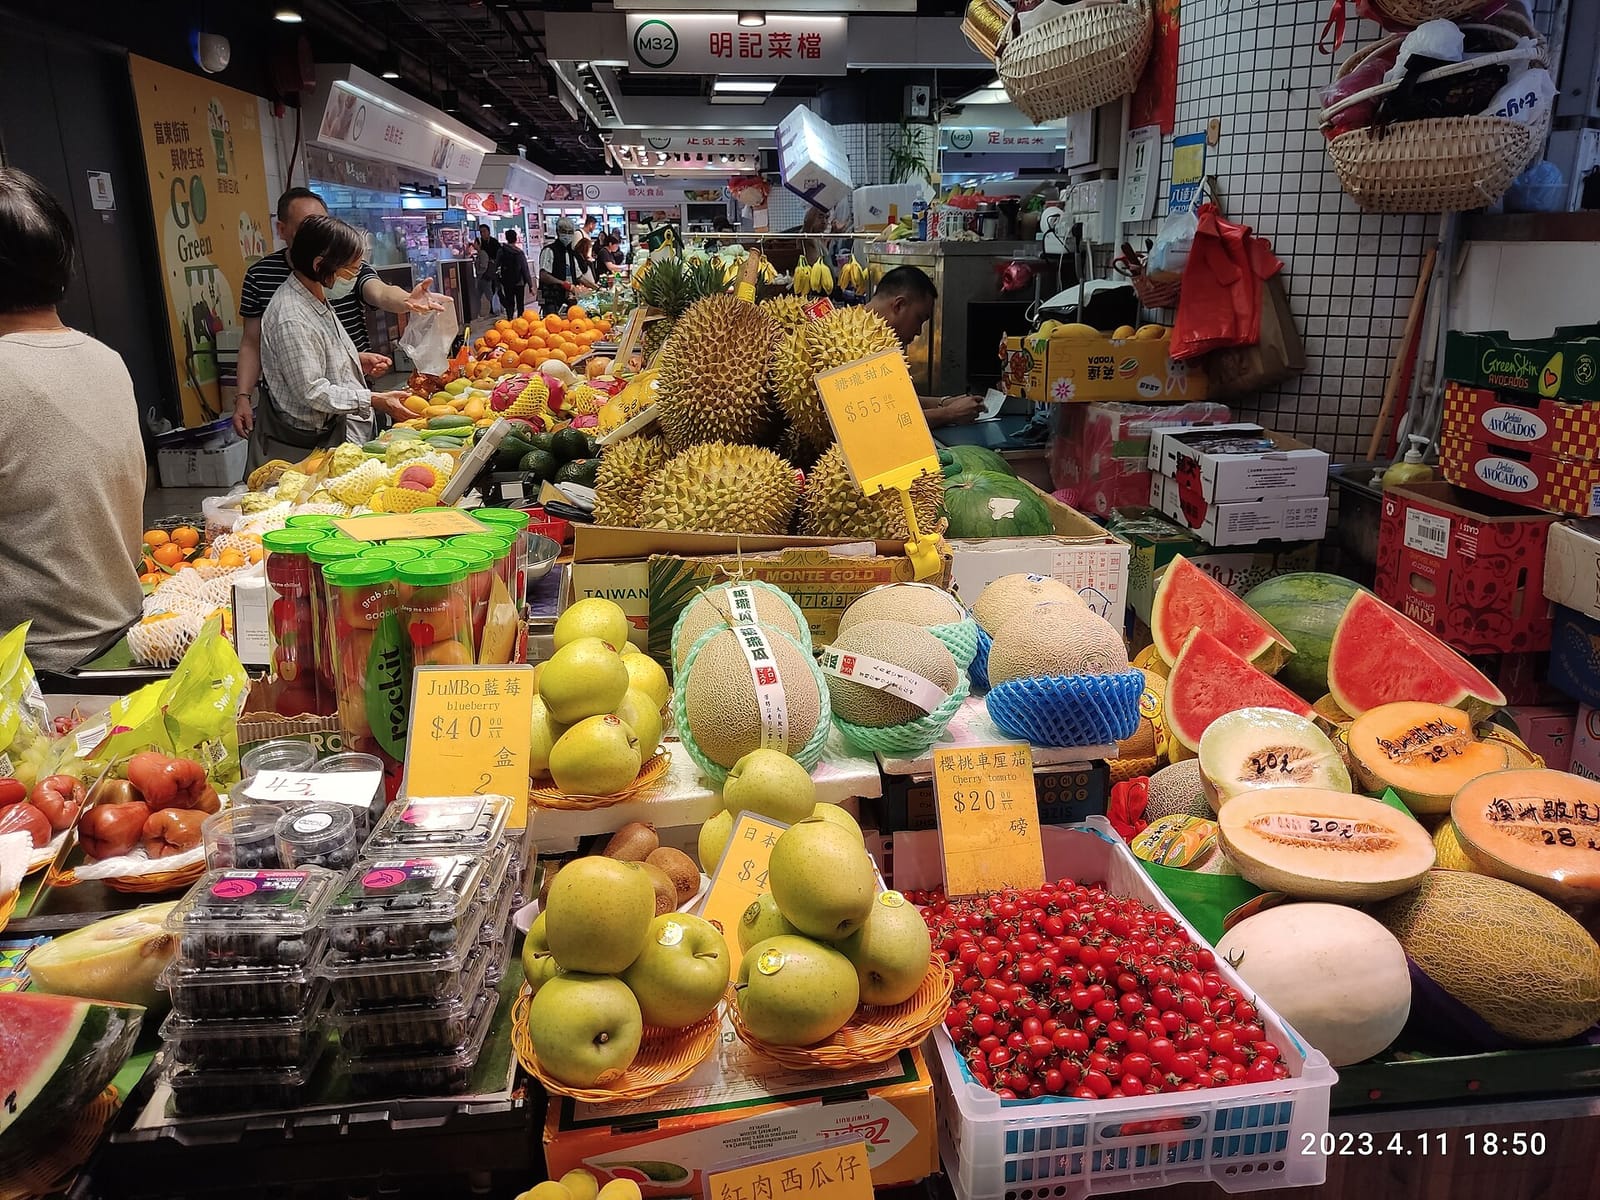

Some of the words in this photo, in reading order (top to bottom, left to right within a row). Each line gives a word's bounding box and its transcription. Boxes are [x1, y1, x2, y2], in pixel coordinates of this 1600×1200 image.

[639, 37, 673, 50] M32
[709, 31, 822, 60] 明記菜檔
[153, 120, 190, 145] 富東街市
[170, 148, 206, 172] 與你生活
[1134, 142, 1147, 169] 11
[177, 233, 214, 264] Green
[1087, 356, 1115, 365] YOODA
[1488, 374, 1529, 389] AVOCADOS
[844, 396, 882, 424] $55
[896, 411, 913, 429] 個
[1488, 418, 1537, 439] AVOCADOS
[1481, 467, 1529, 489] AVOCADOS
[766, 569, 825, 582] MONTE
[830, 569, 875, 581] GOLD
[361, 591, 383, 610] grab
[583, 588, 649, 599] TAIWAN
[804, 595, 812, 607] 7
[820, 595, 829, 607] 8
[836, 594, 843, 606] 9
[1405, 594, 1436, 613] CRUNCH
[1404, 601, 1435, 627] KIWI
[378, 644, 408, 742] rockit
[482, 677, 521, 697] 藍莓
[447, 701, 501, 712] blueberry
[492, 746, 517, 768] 盒
[938, 750, 1027, 773] 櫻桃車厘茄
[952, 775, 983, 784] Cherry
[988, 774, 1018, 782] tomato
[953, 790, 996, 814] $20
[742, 827, 777, 848] 日本
[1008, 817, 1028, 837] 磅
[835, 1114, 870, 1125] KIWIFRUIT
[719, 1153, 863, 1200] 紅肉西瓜仔
